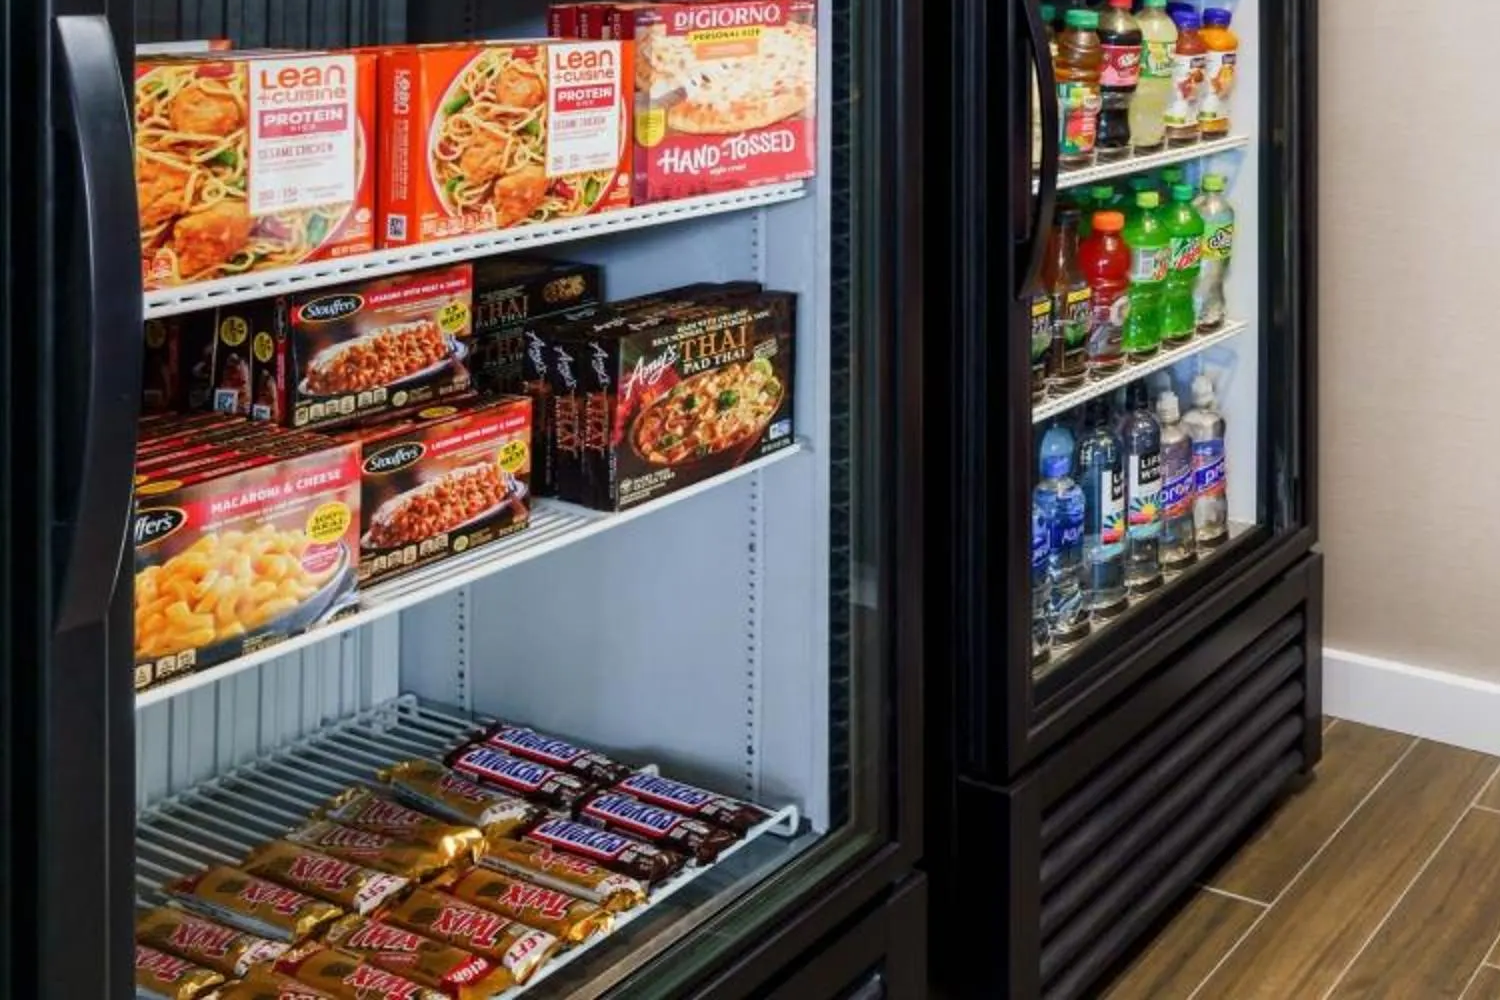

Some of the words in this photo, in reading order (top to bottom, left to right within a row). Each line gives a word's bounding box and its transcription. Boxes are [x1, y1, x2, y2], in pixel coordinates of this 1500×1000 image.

[556, 50, 614, 71] Lean
[260, 64, 346, 91] Lean
[557, 86, 613, 103] PROTEIN
[264, 107, 344, 128] PROTEIN
[657, 130, 796, 175] HAND-TOSSED
[306, 299, 358, 319] Stouffer's
[679, 326, 750, 363] THAI
[622, 344, 680, 400] Amy's
[684, 357, 710, 374] PAD
[712, 349, 746, 367] THAI
[210, 486, 280, 513] MACARONI
[283, 482, 294, 495] &
[296, 471, 342, 490] CHEESE
[446, 957, 489, 984] RIGH
